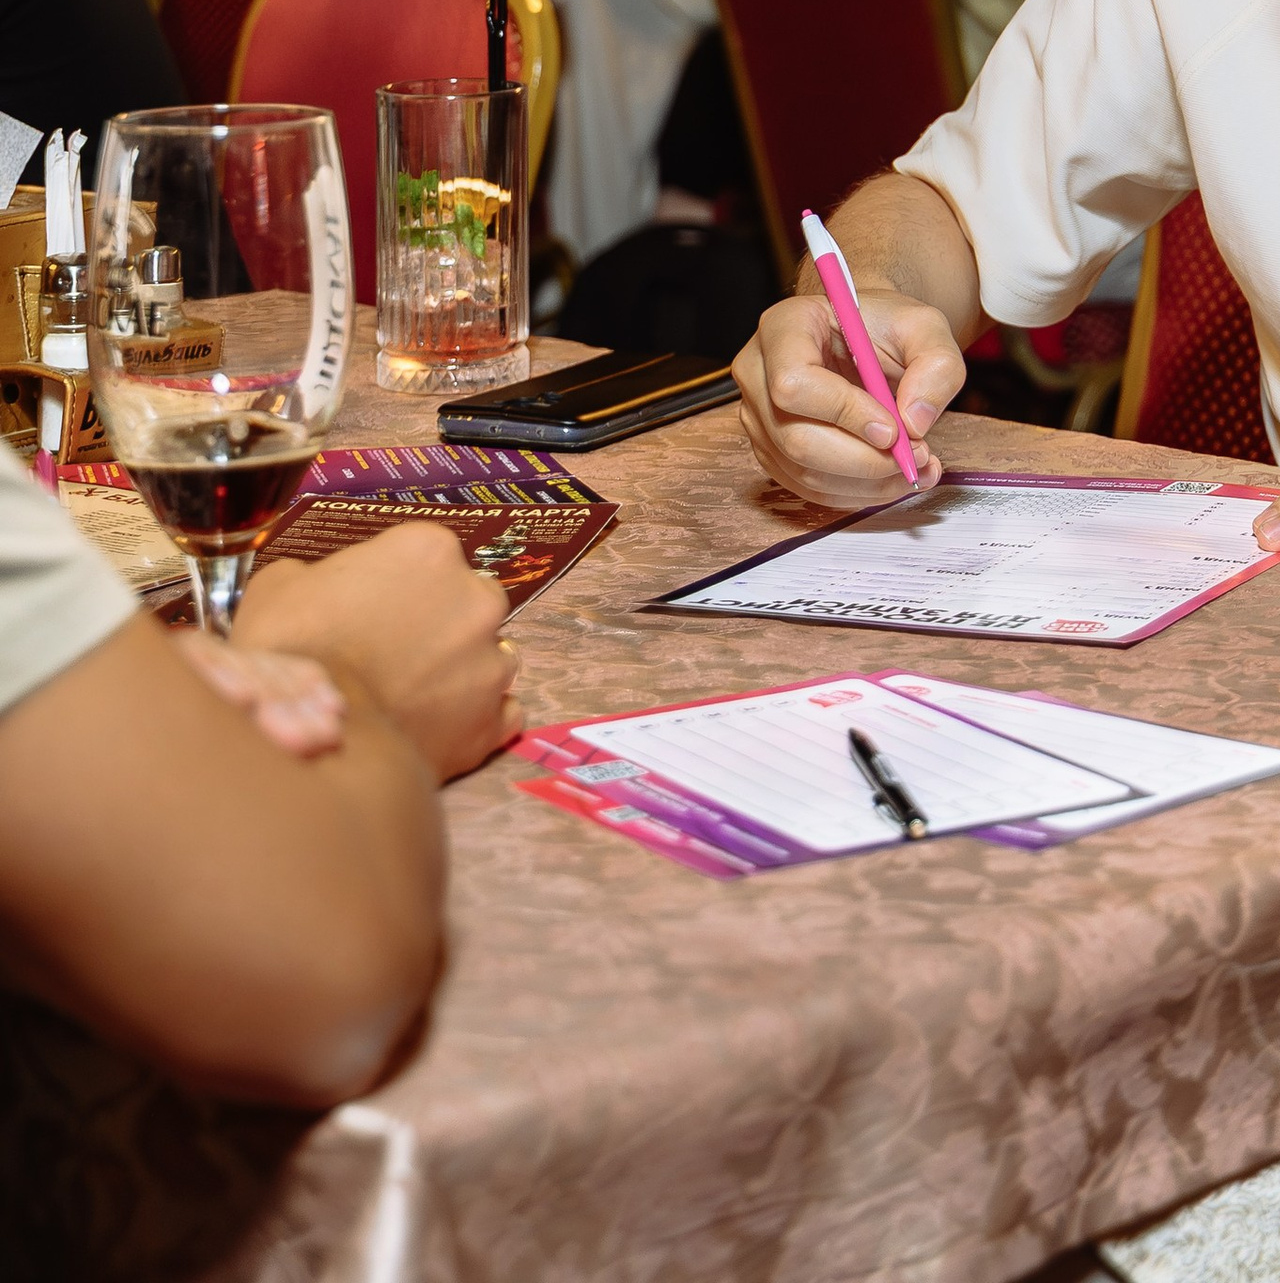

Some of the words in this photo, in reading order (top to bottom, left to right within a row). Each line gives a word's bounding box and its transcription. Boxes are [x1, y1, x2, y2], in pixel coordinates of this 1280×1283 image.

[311, 500, 503, 517] КОКТЕЙЛЬНАЯ
[509, 508, 592, 517] КАРТА
[1204, 557, 1249, 565] РАУНД
[688, 598, 800, 611] ЛИСТ
[803, 607, 967, 625] ПРОСТО
[952, 611, 1042, 623] ДЛЯ
[970, 620, 1025, 629] НЕ
